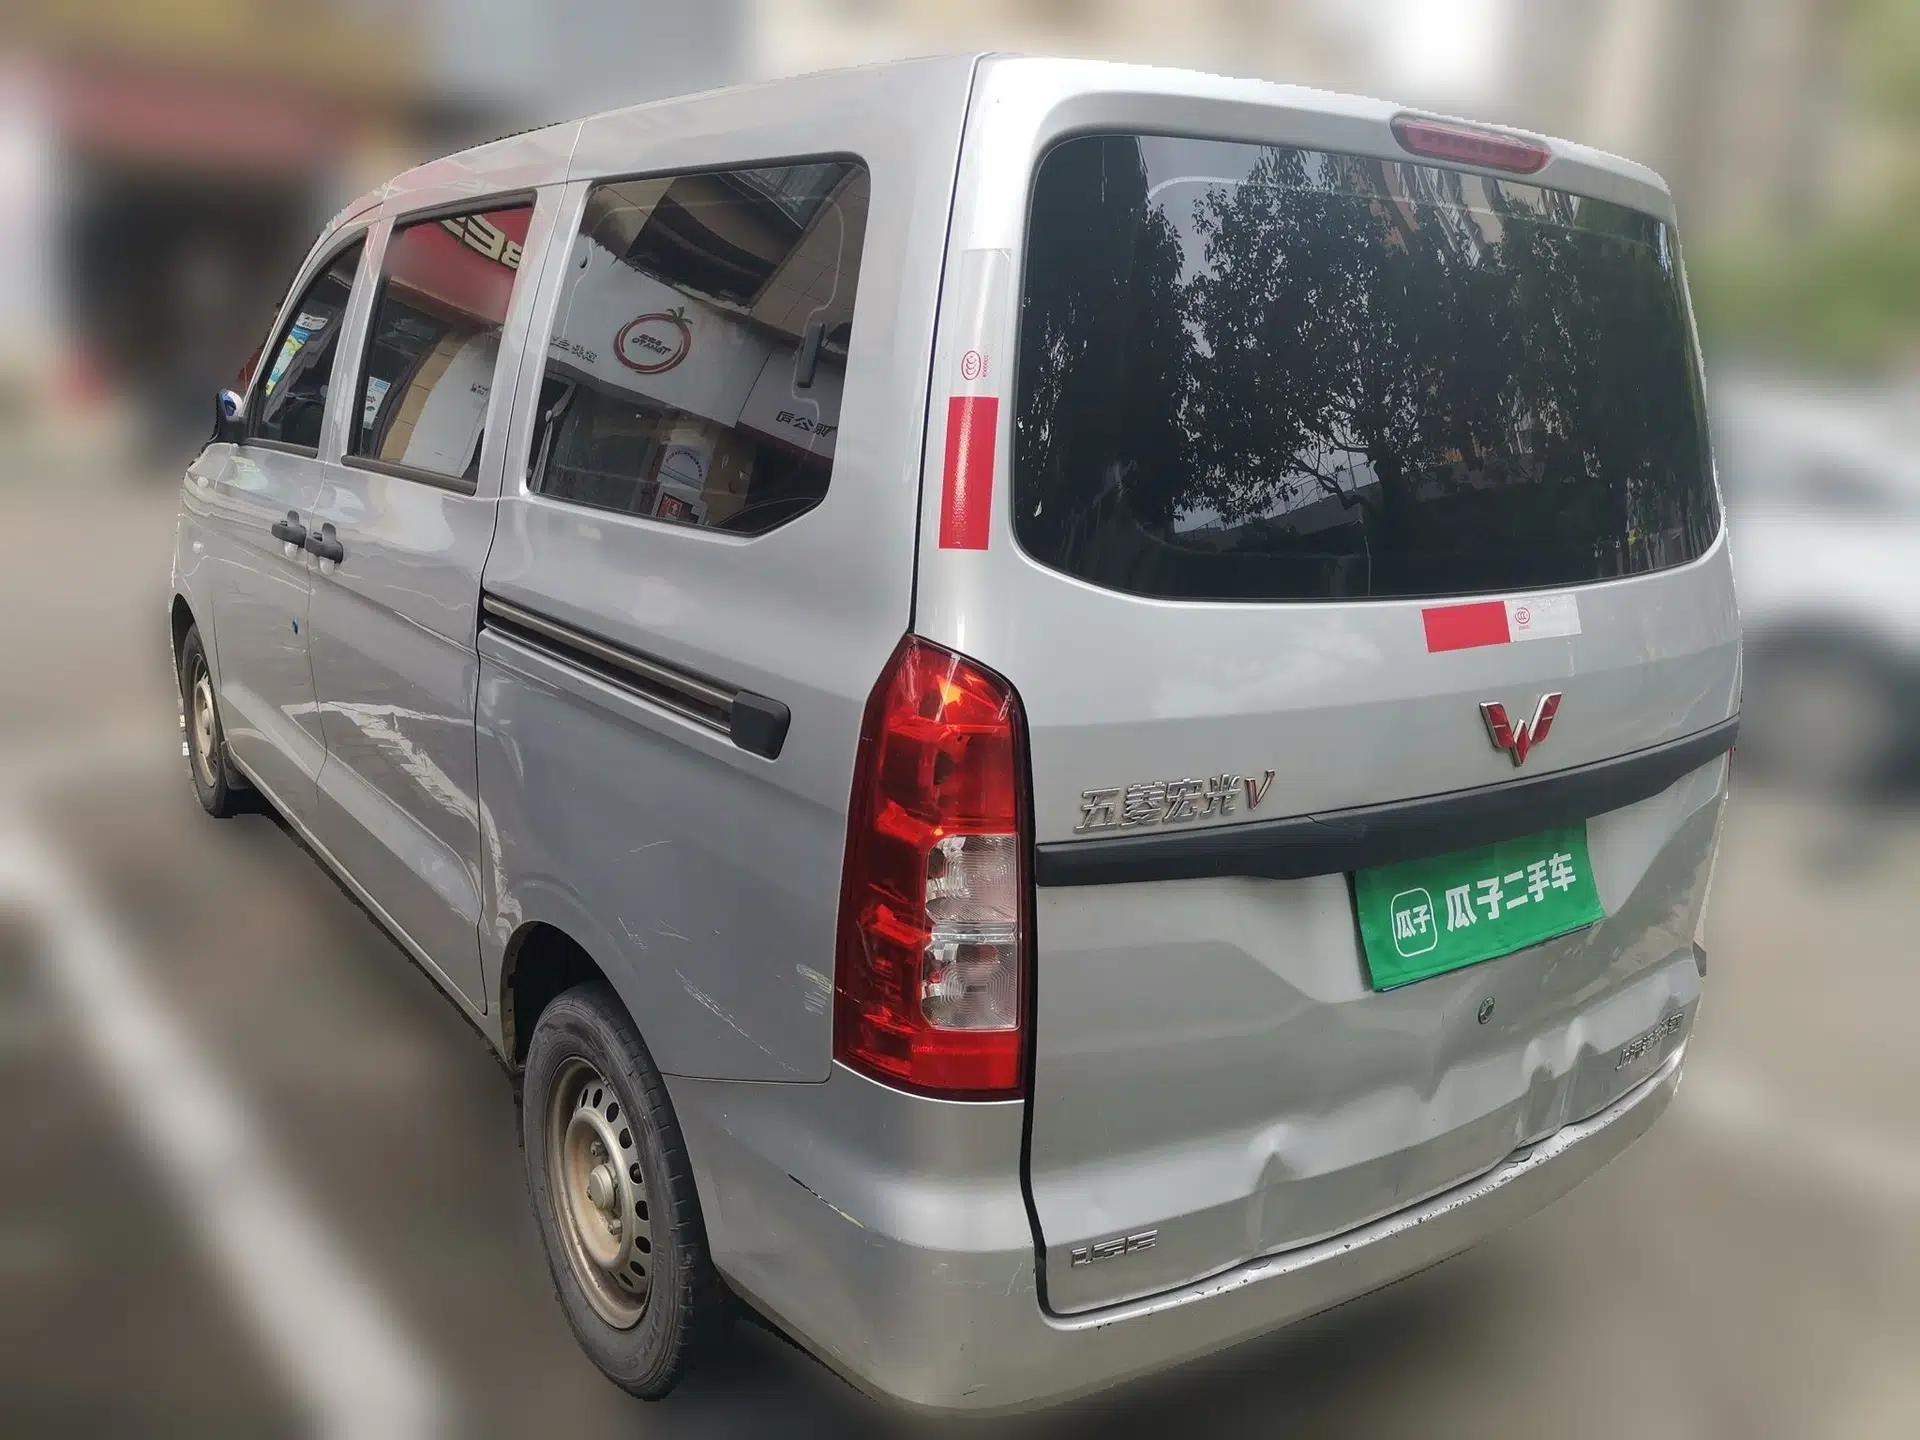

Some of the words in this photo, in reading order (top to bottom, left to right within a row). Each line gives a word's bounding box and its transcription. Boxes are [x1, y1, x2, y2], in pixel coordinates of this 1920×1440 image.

[1445, 852, 1577, 932] 瓜子二手车
[1395, 904, 1431, 940] 瓜子
